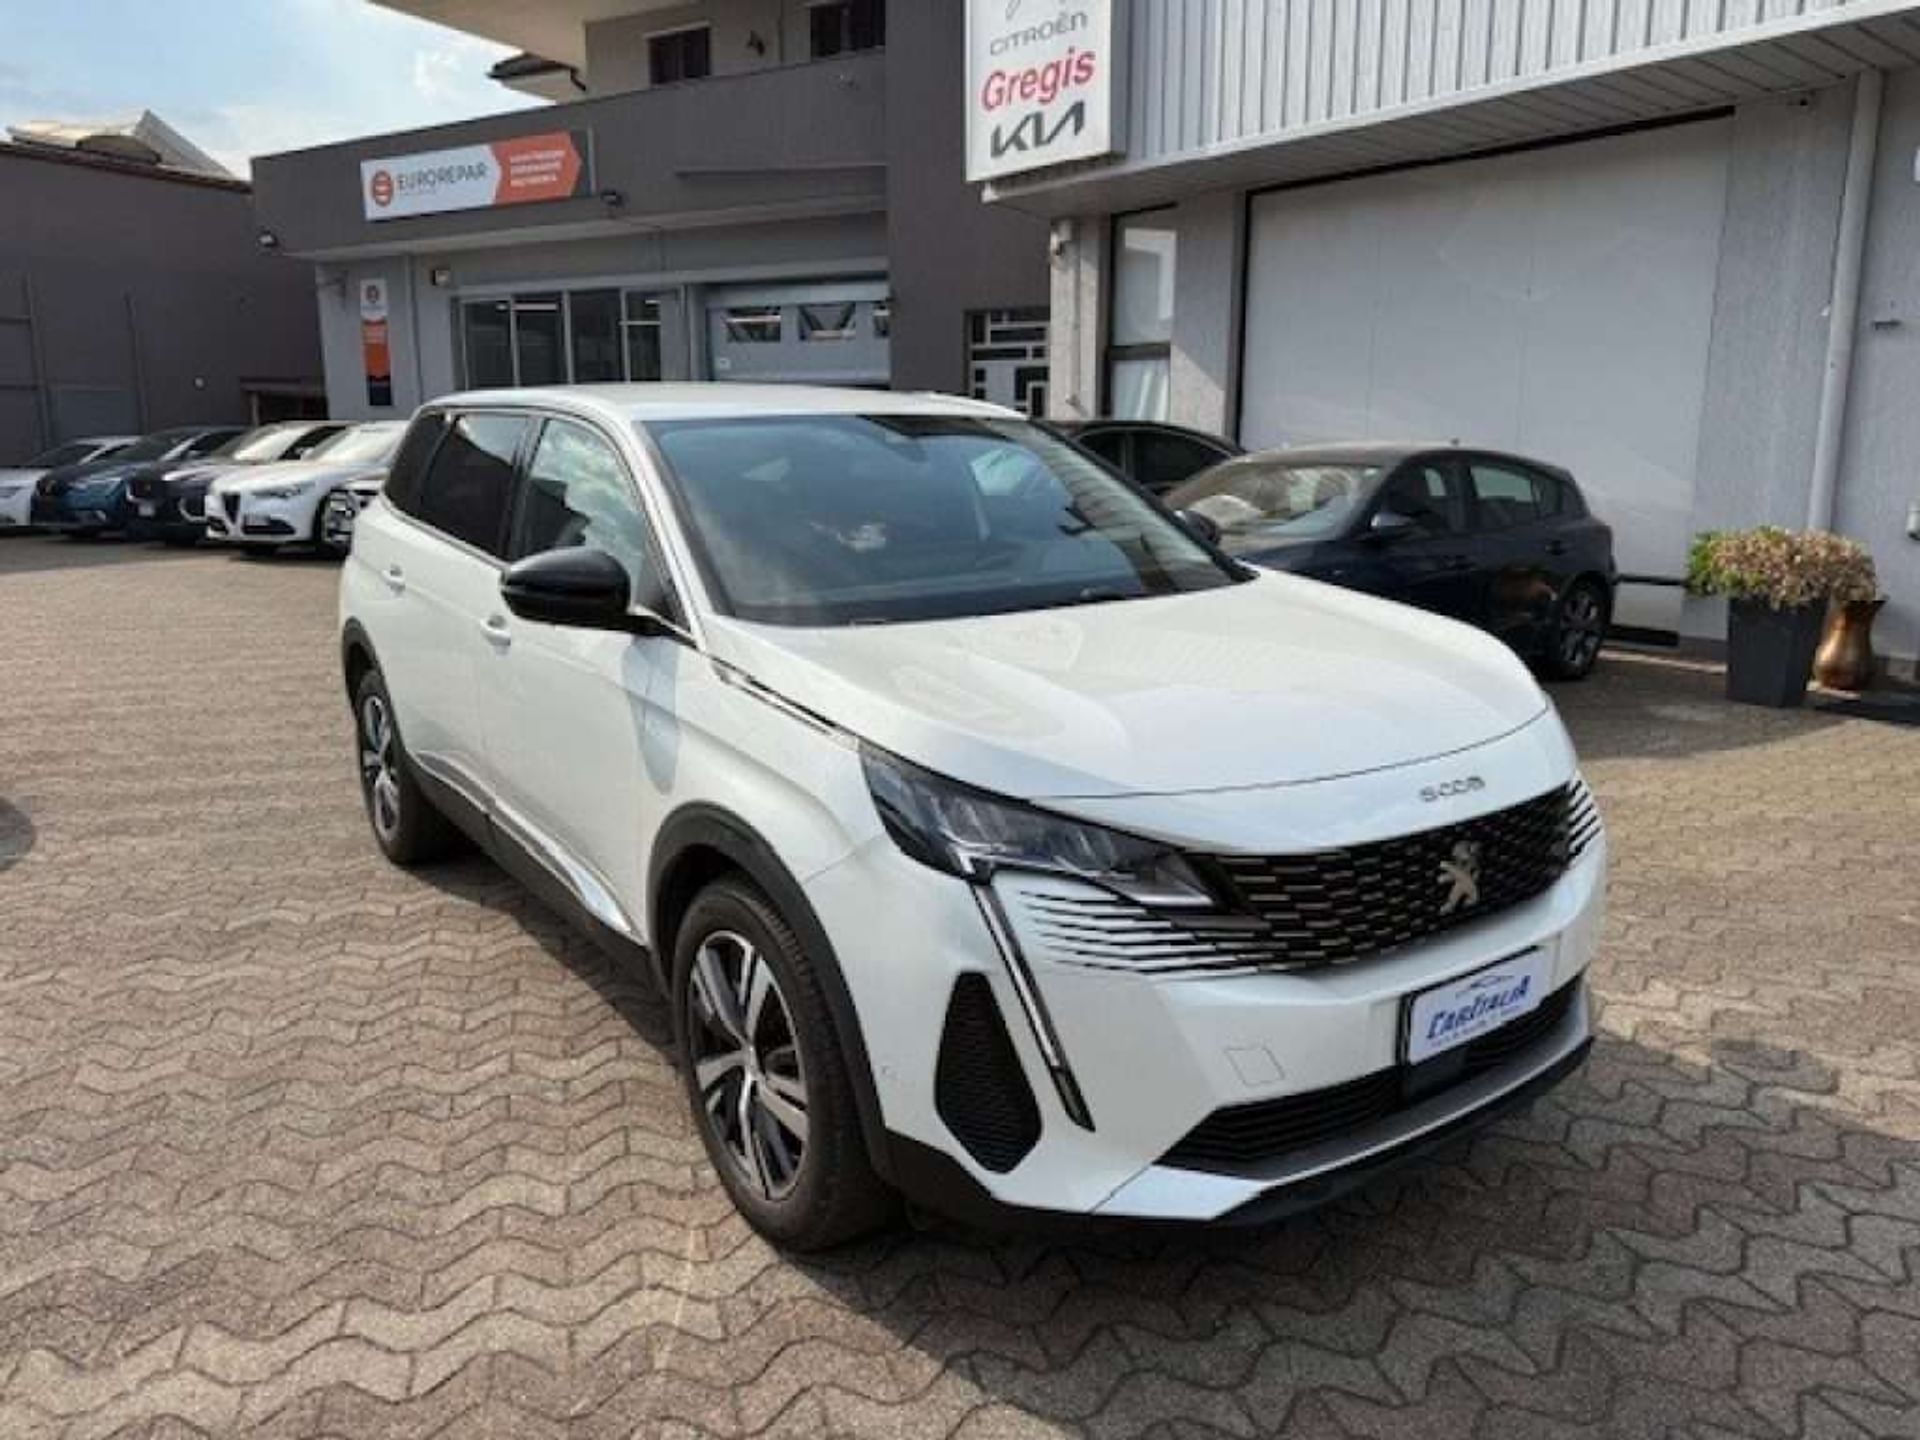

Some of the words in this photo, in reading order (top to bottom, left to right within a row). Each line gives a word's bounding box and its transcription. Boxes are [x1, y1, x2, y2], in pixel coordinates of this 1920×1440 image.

[982, 46, 1096, 112] Gregis
[990, 99, 1085, 158] KIA
[398, 162, 487, 190] EUROREPAR
